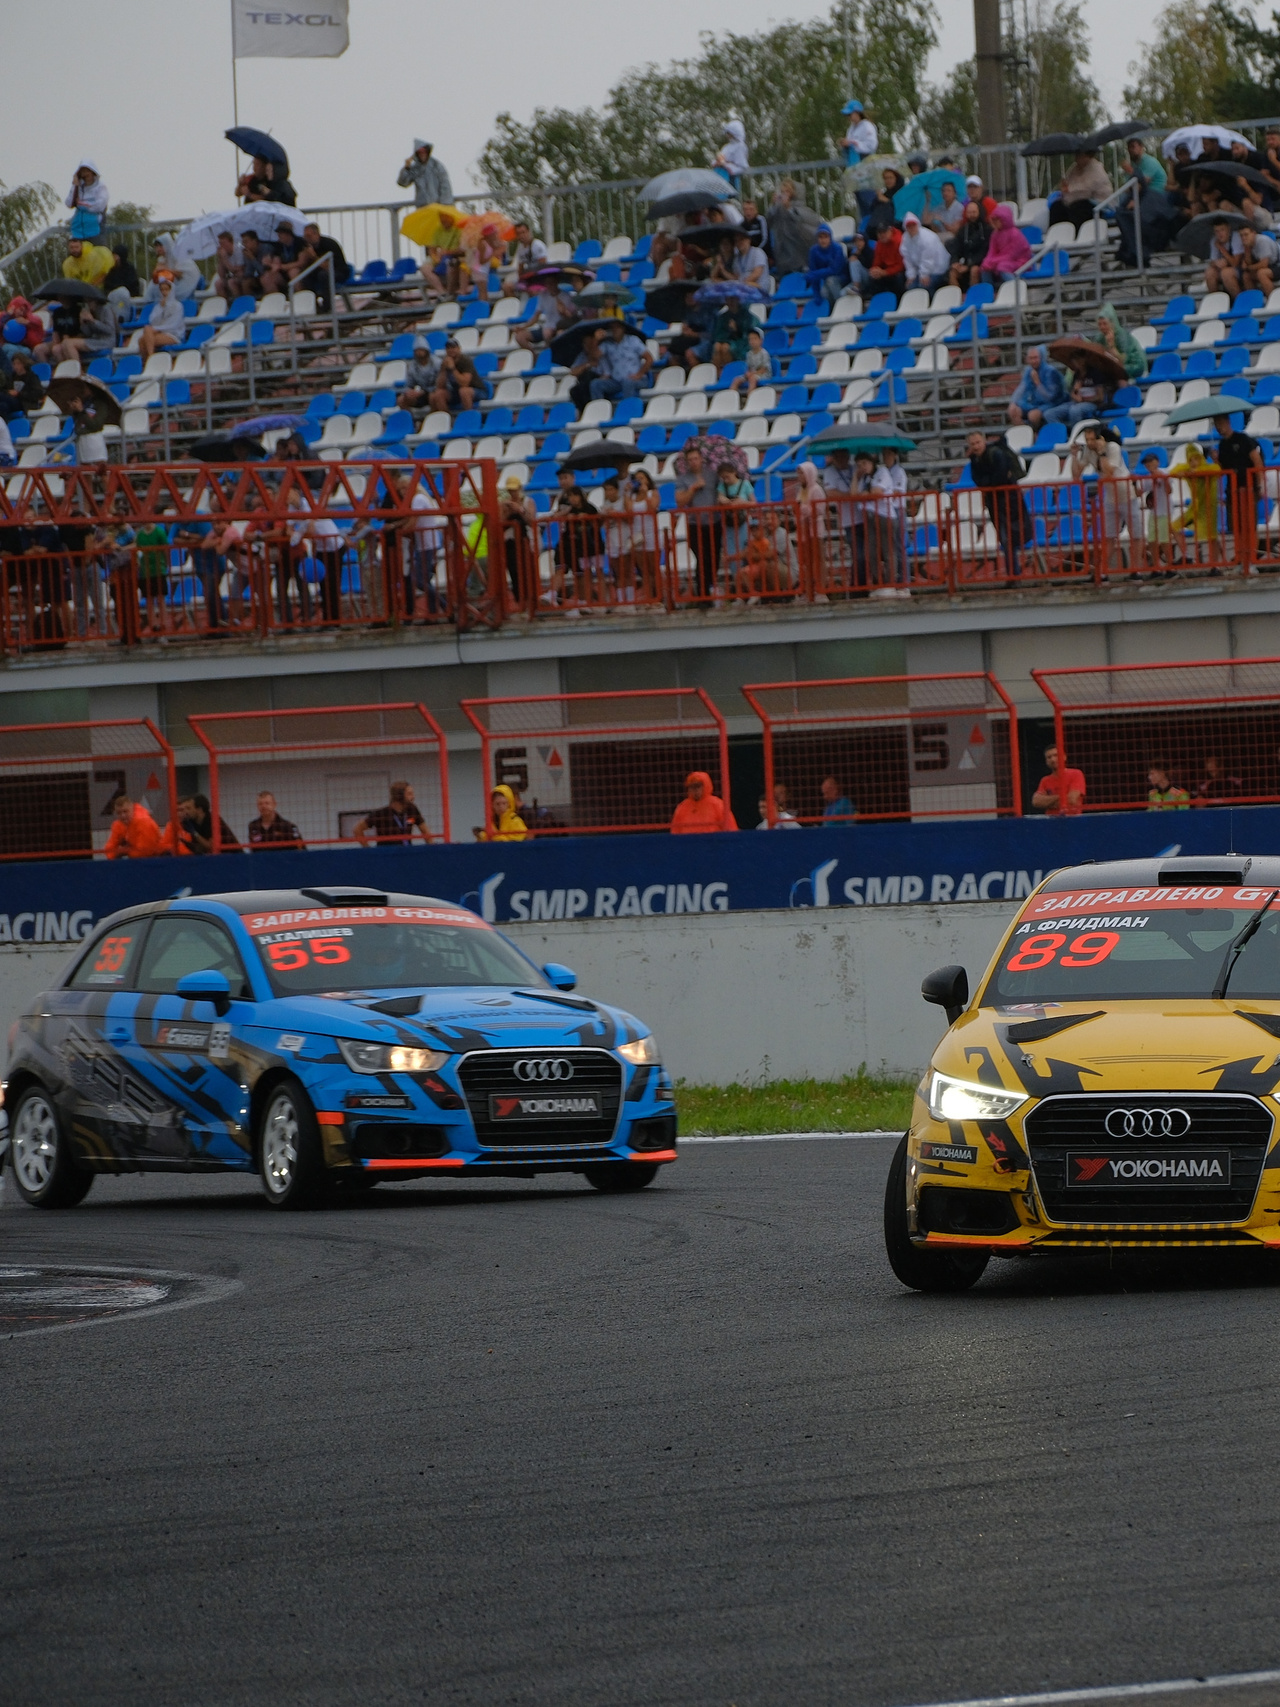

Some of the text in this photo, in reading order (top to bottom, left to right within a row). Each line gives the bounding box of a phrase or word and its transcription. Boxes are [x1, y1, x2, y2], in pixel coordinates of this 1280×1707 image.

[246, 12, 342, 27] TEXOL
[914, 723, 950, 772] 5
[94, 770, 127, 816] 7
[509, 881, 729, 922] SMP RACING
[844, 868, 1058, 905] SMP RACIN
[1035, 886, 1223, 913] ЗАПРАВЛЕНО
[251, 907, 387, 929] ЗАПРАВЛЕНО
[1015, 915, 1150, 935] А.ФРИДМАН
[94, 936, 132, 972] 55
[266, 937, 351, 971] 55
[1006, 931, 1120, 972] 89
[518, 1098, 598, 1114] YOKOHAMA
[931, 1146, 973, 1160] YOKOHAMA
[1108, 1158, 1223, 1178] YOKOHAMA
